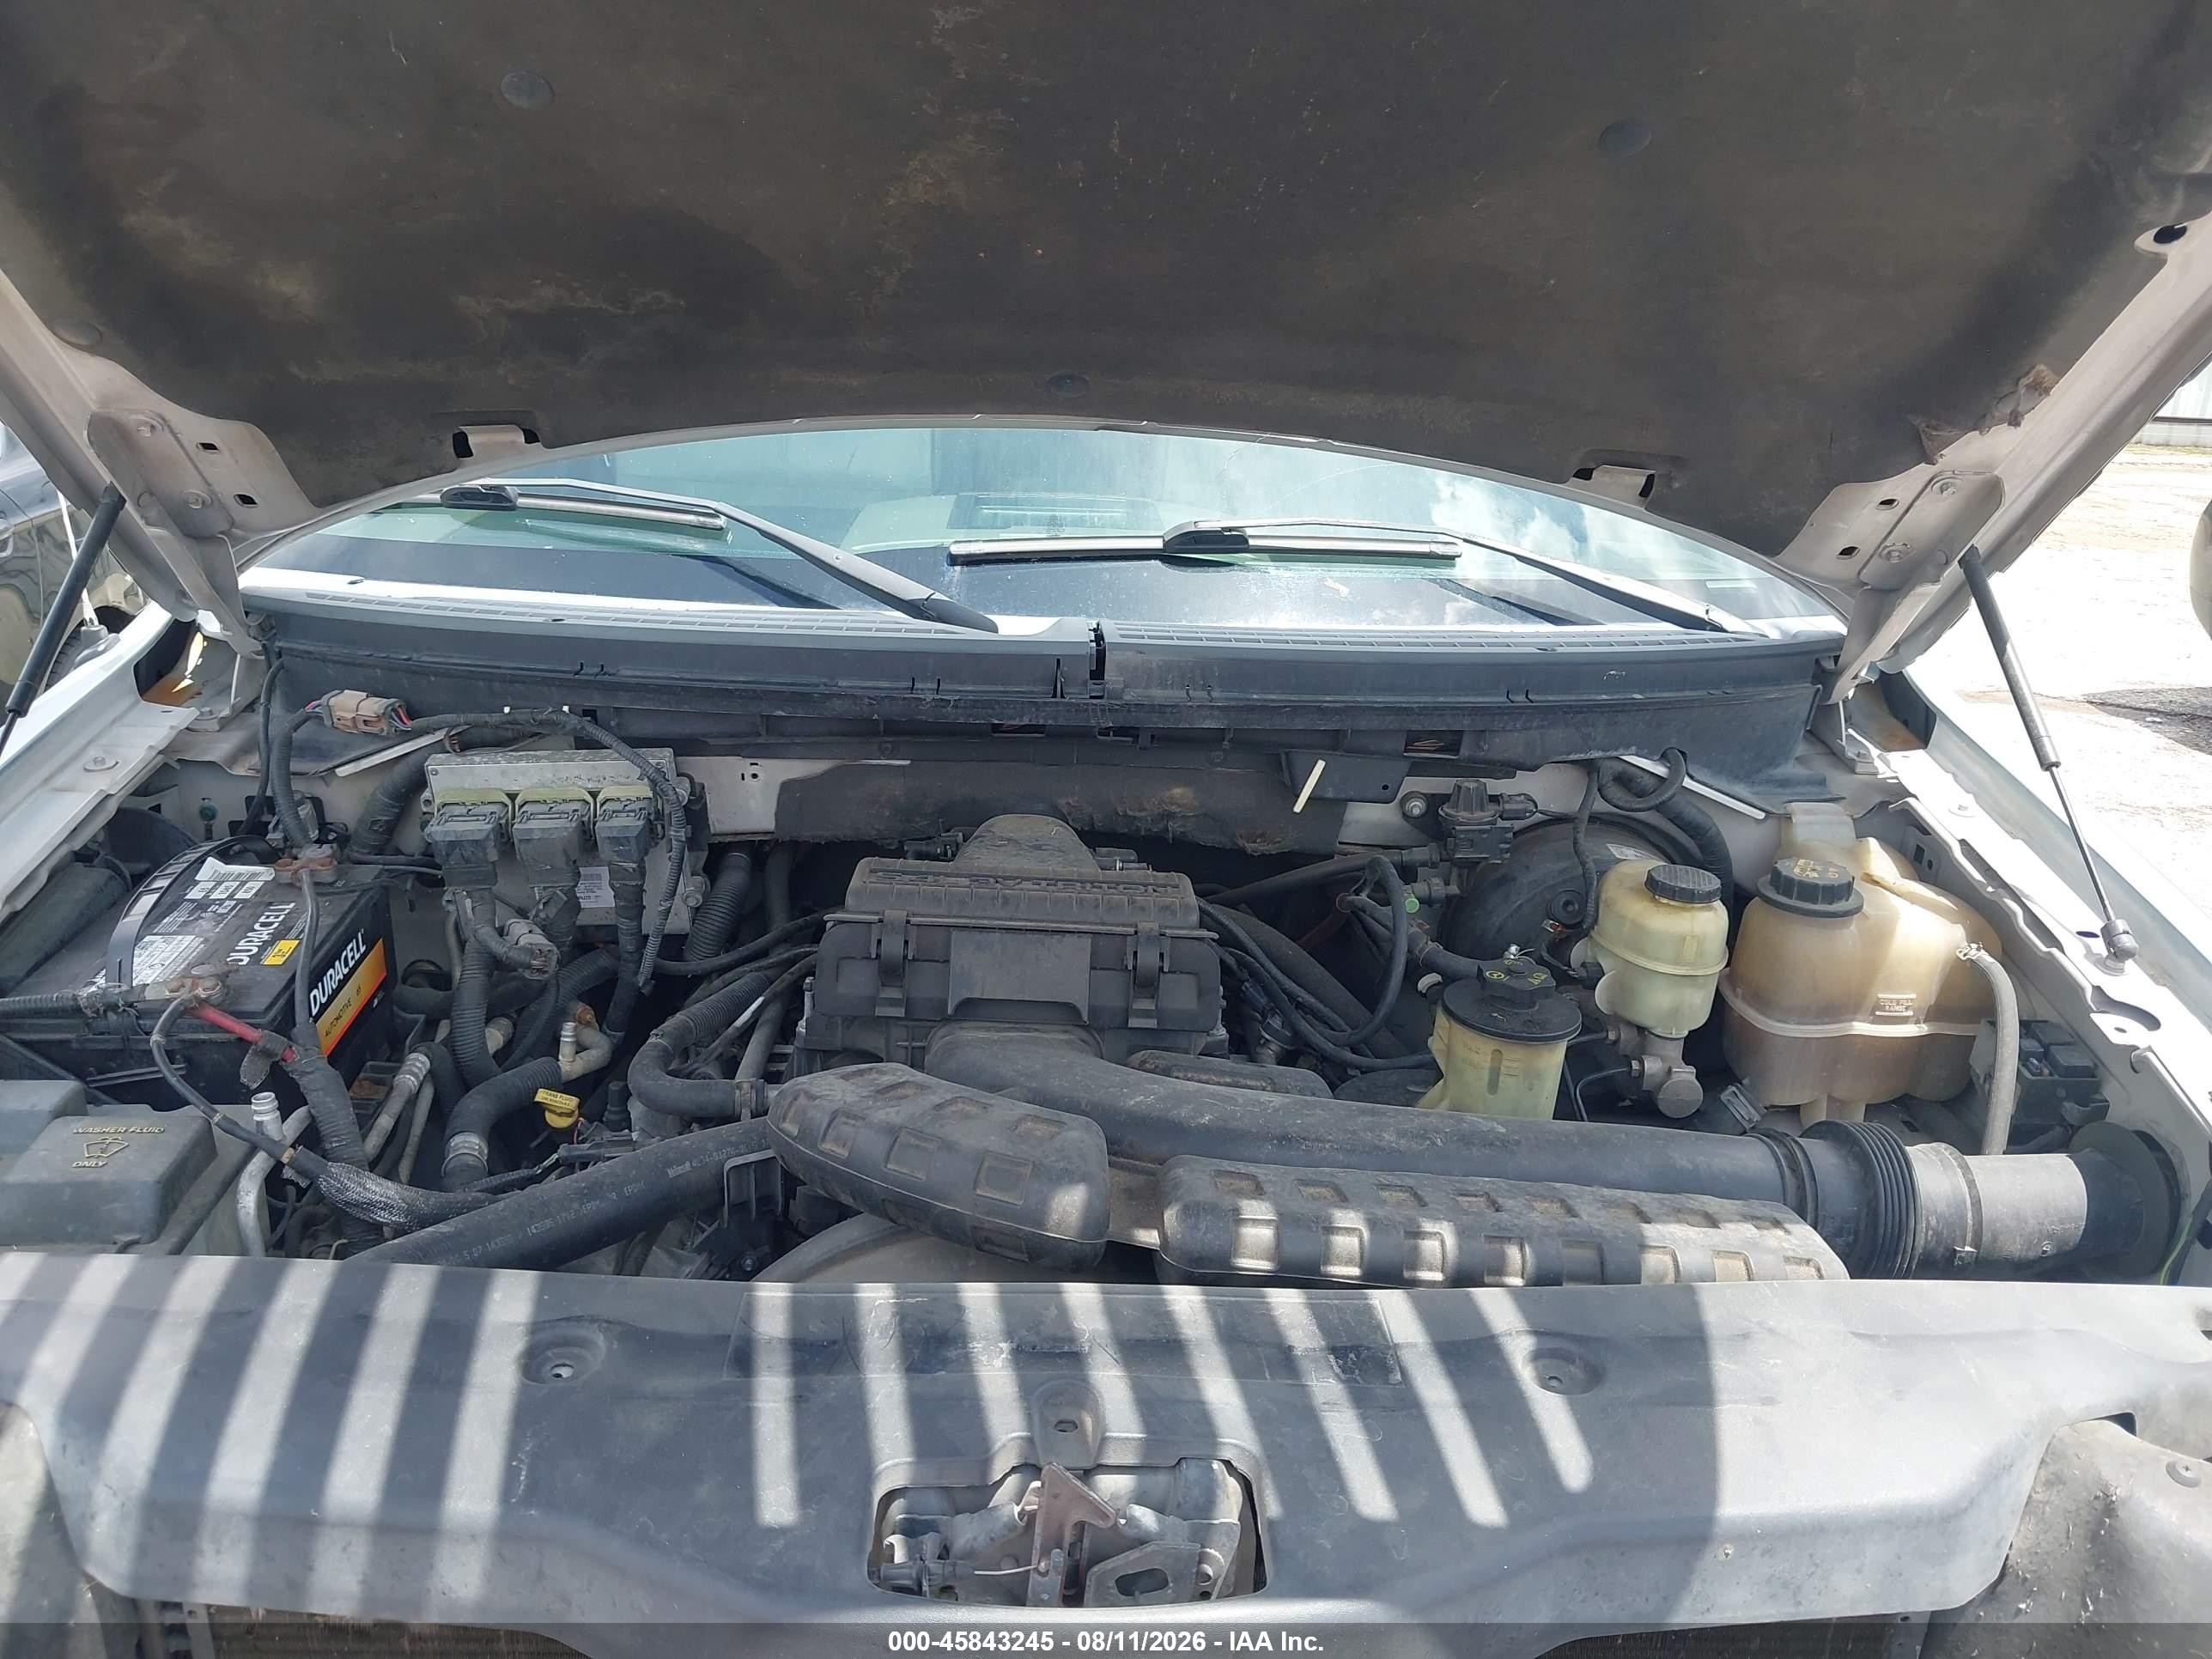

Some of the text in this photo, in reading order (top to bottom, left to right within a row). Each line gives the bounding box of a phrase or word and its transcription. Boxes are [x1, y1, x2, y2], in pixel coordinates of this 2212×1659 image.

[1030, 879, 1178, 895] TRITON
[309, 931, 367, 1018] DURACELL
[324, 997, 353, 1038] AUTOMOTIVE
[72, 1126, 165, 1134] WASHER FLUID
[71, 1160, 109, 1169] ONLY
